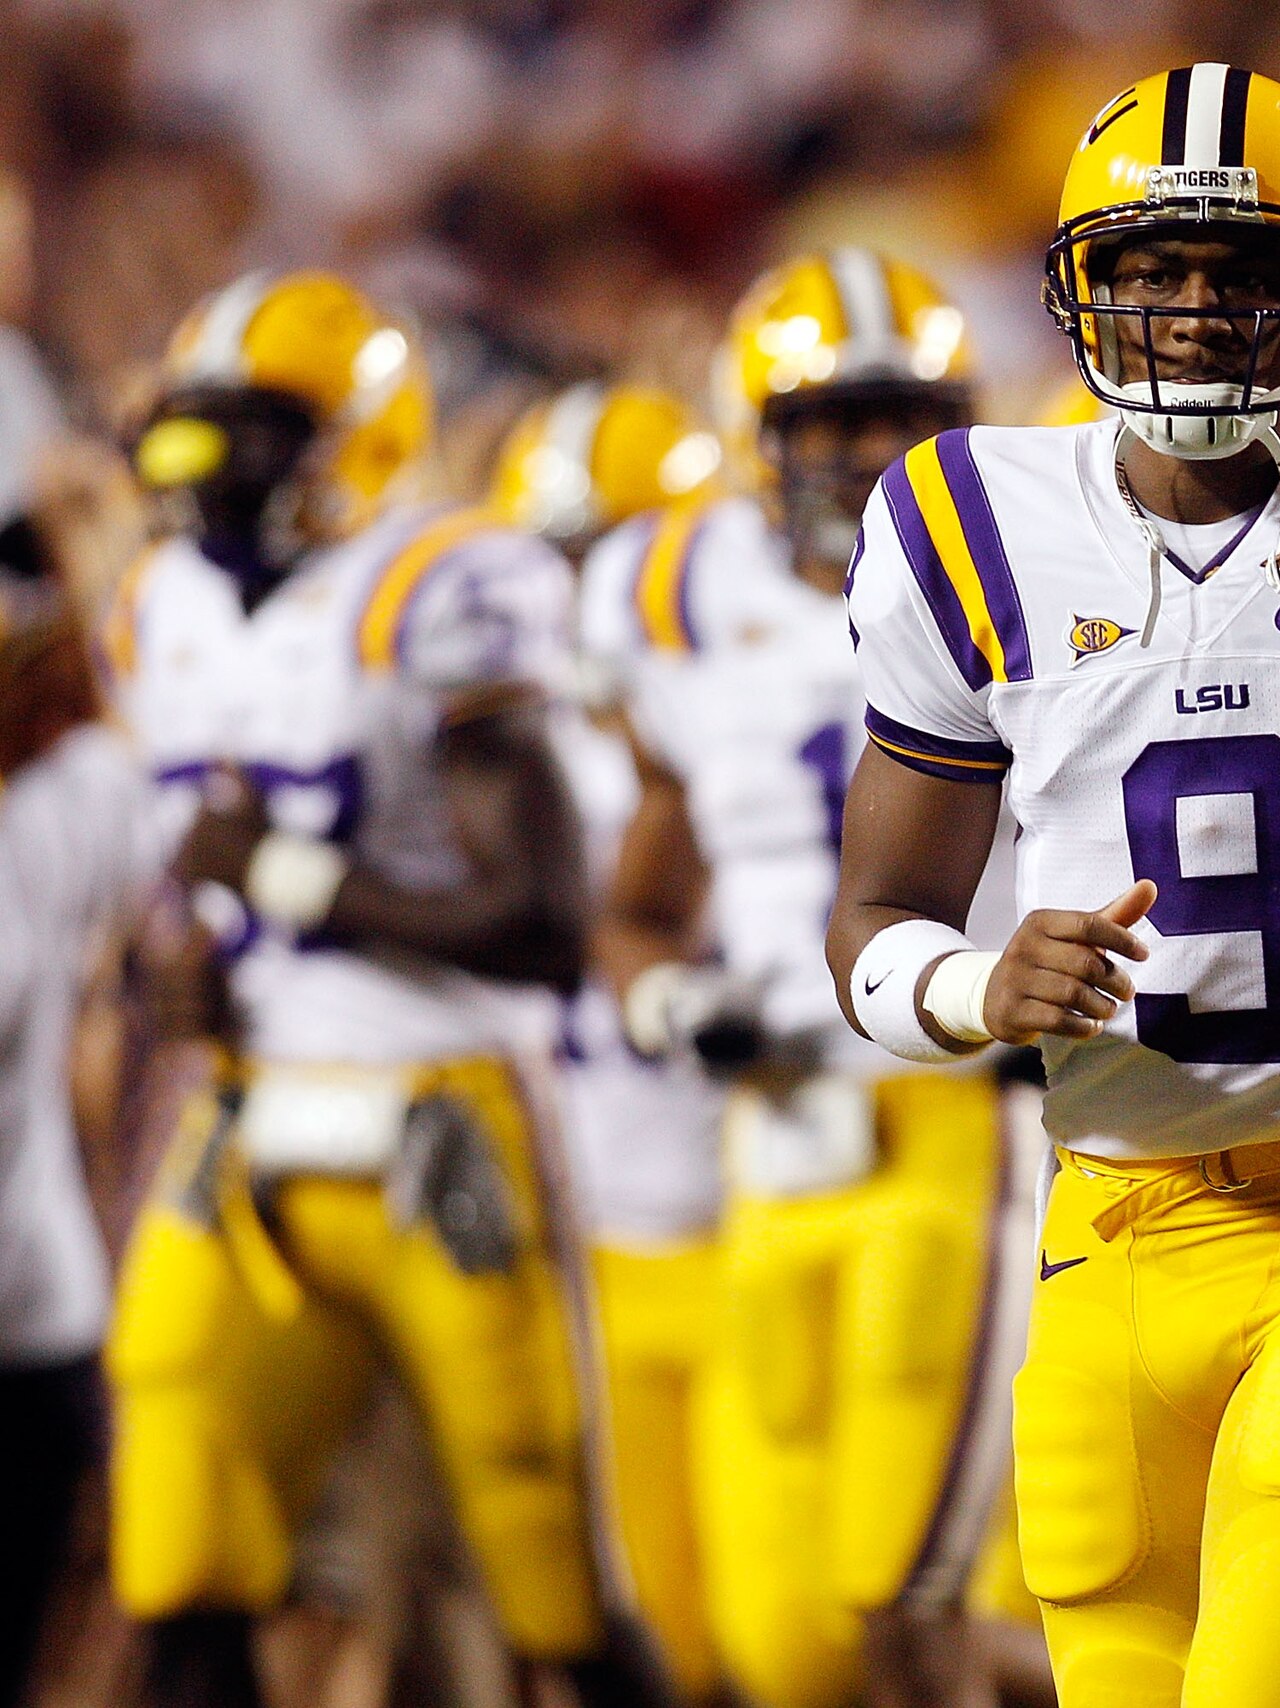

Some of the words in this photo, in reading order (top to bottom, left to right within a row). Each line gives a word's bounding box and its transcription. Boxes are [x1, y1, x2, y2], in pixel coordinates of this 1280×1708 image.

[1175, 171, 1229, 188] TIGERS
[1080, 622, 1108, 650] SEC
[1175, 684, 1250, 714] LSU
